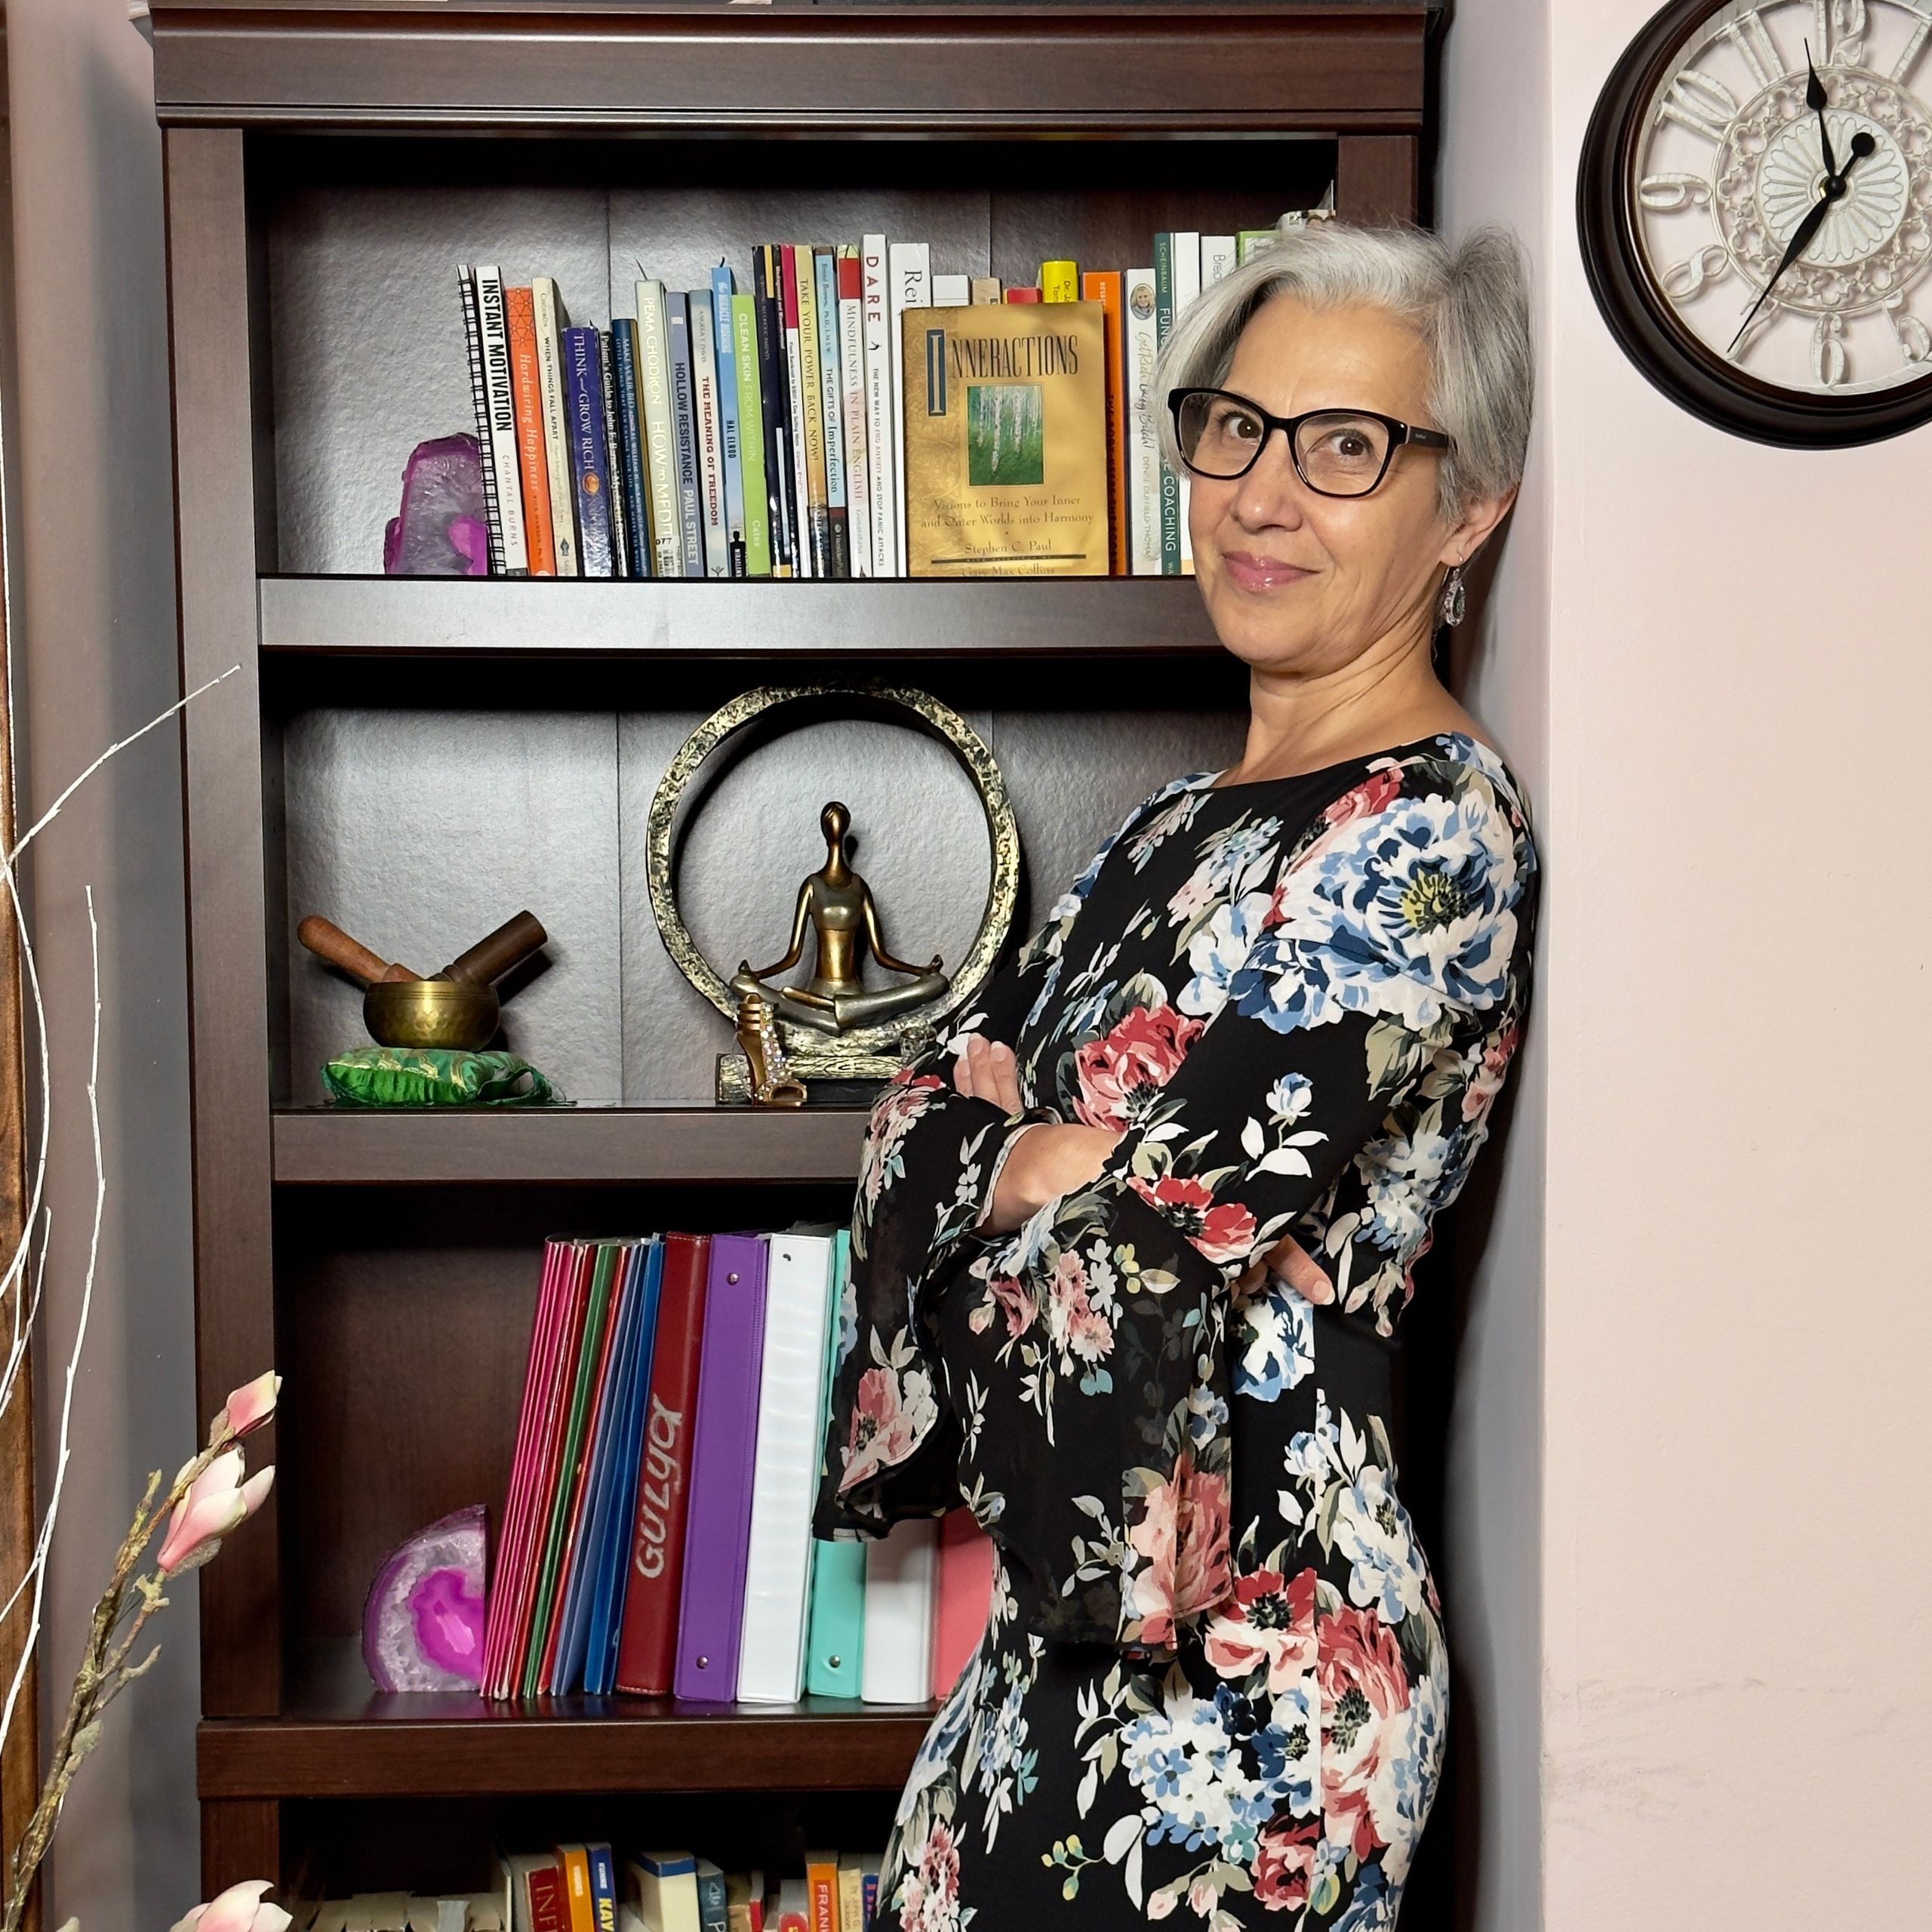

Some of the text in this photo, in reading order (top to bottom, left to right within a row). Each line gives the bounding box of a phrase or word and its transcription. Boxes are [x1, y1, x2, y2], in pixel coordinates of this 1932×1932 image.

[1654, 70, 1737, 143] 10
[1639, 173, 1712, 209] 9
[1159, 242, 1168, 294] SCHEINBAUM
[1662, 245, 1727, 297] 8
[866, 257, 881, 322] DARE
[904, 270, 923, 303] Rei
[643, 297, 655, 332] PEMA
[718, 294, 731, 322] MIRACLE
[482, 279, 512, 431] INSTANT MOTIVATION
[600, 335, 612, 371] Patient's
[622, 338, 631, 362] MAKE
[721, 323, 732, 354] MORNING
[1136, 332, 1152, 352] Get
[1810, 311, 1844, 388] 6
[625, 365, 633, 389] YOUR
[800, 278, 819, 461] TAKE YOUR POWER BACK NOW!
[931, 334, 1078, 413] INNERACTIONS
[1137, 353, 1154, 378] Rich
[574, 333, 593, 469] THINK GROW RICH
[604, 372, 614, 398] Guide
[627, 392, 635, 408] BED
[738, 313, 756, 461] CLEAN SKIN FROM WITHIN
[826, 389, 835, 410] GIFTS
[846, 305, 863, 499] MINDFULNESS IN PLAIN ENGLISH
[606, 400, 613, 408] to
[607, 410, 616, 430] John
[828, 411, 835, 423] OF
[519, 354, 539, 491] Hardwiring Happiness
[550, 416, 558, 440] APART
[675, 362, 693, 484] HOLLOW RESISTANCE
[726, 420, 737, 459] HAL ELROD
[874, 418, 881, 427] TO
[651, 421, 668, 464] HOW
[702, 377, 718, 526] THE MEANING OF FREEDOM
[827, 426, 838, 493] Imperfection
[503, 455, 518, 546] CHANTAL BURNS
[934, 495, 1081, 509] Visions to Bring Your Inner
[1142, 457, 1152, 560] DENISE DUFFIELD-THOMAS
[1164, 476, 1176, 552] COACHING
[683, 489, 699, 565] PAUL STREET
[752, 520, 761, 547] Cates
[921, 512, 1094, 528] and Outer Worlds into Harmony
[964, 539, 1051, 555] Stephen C. Paul
